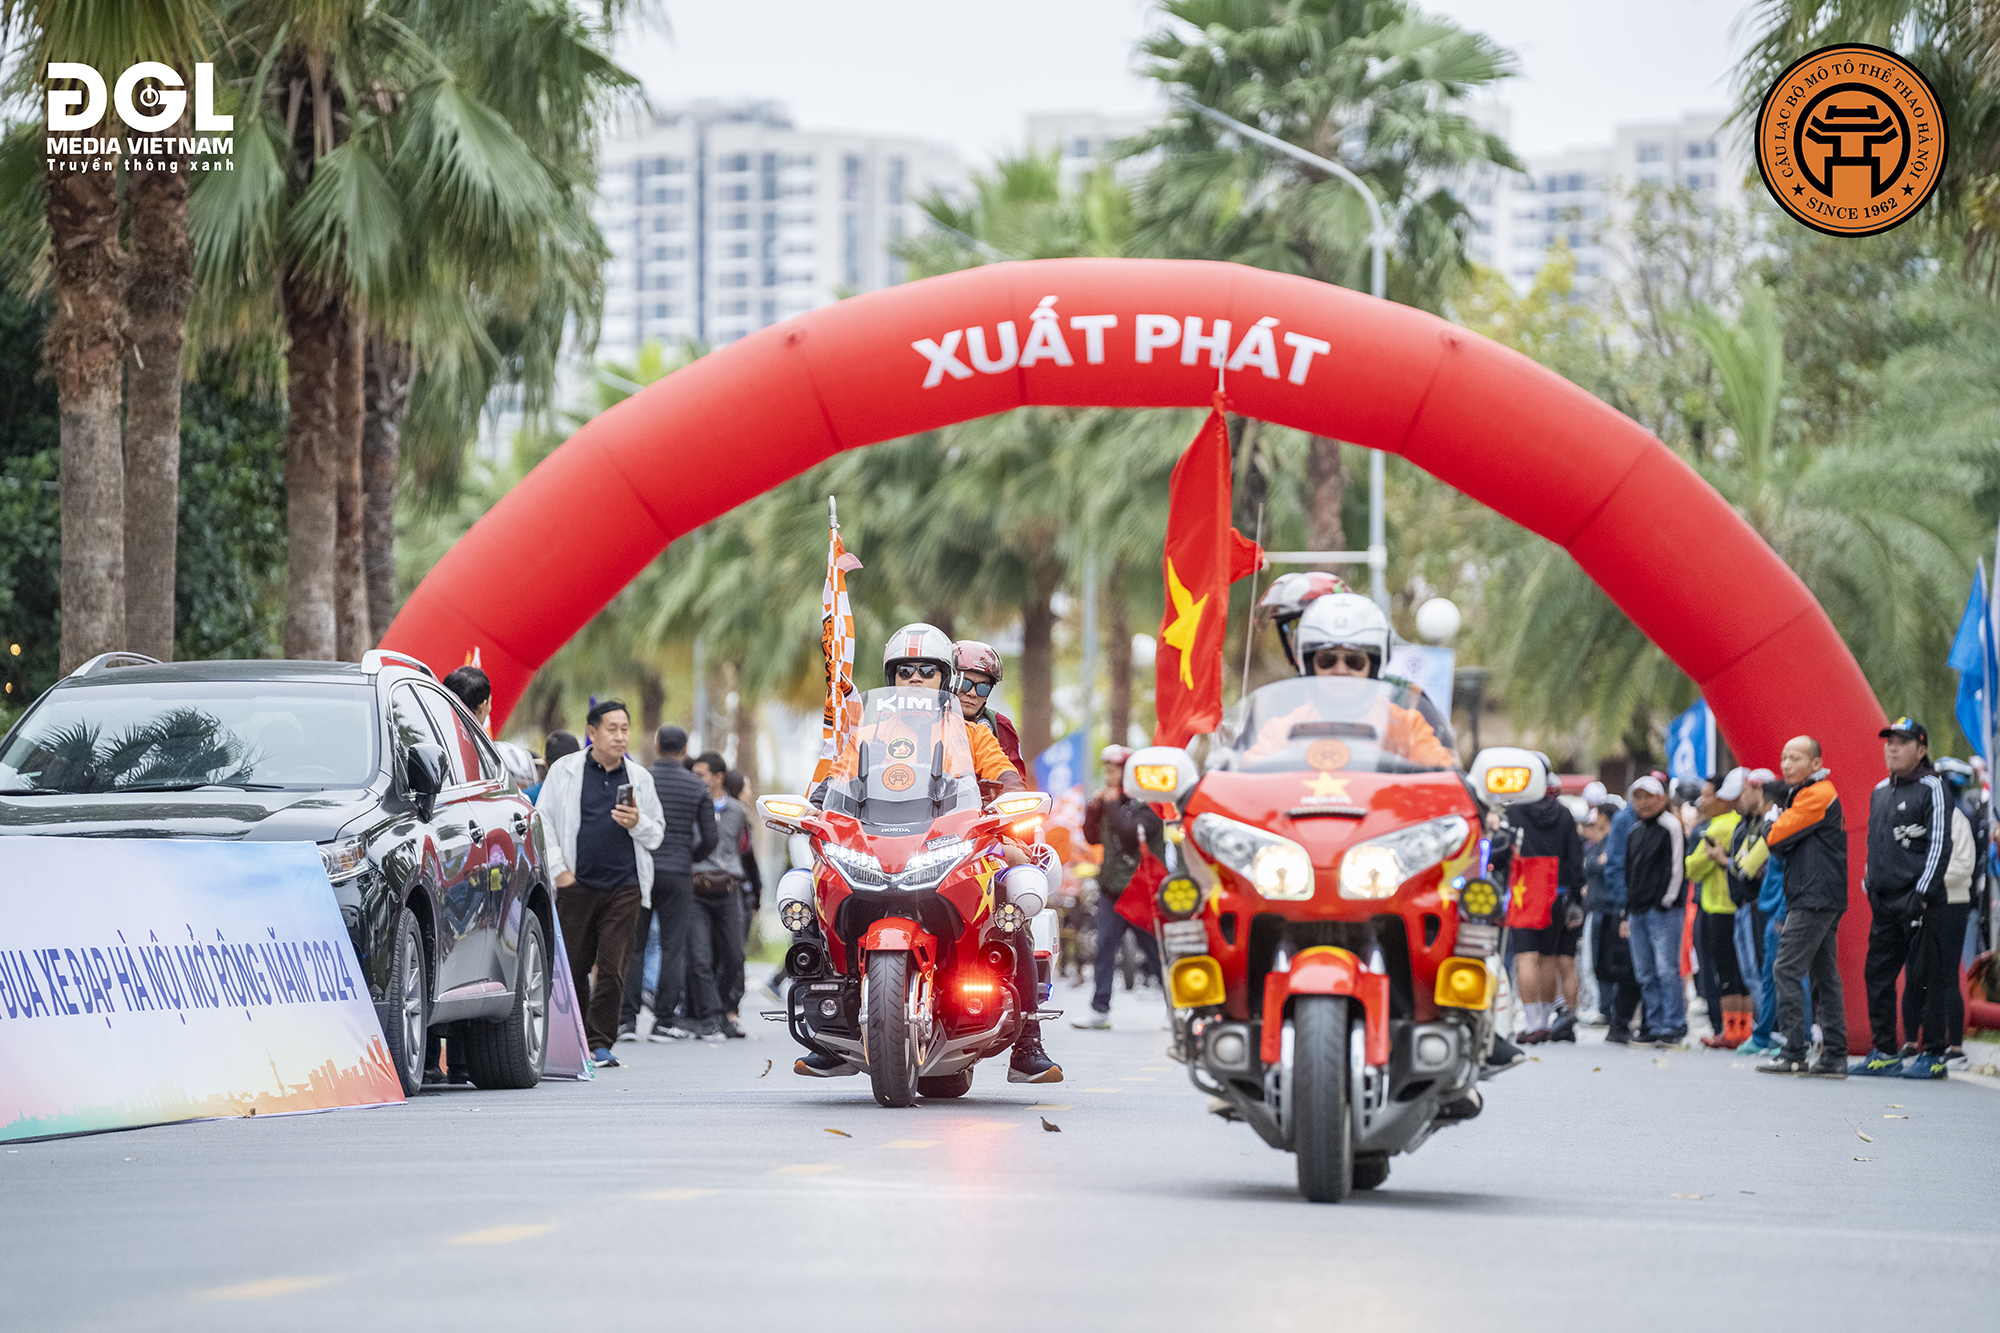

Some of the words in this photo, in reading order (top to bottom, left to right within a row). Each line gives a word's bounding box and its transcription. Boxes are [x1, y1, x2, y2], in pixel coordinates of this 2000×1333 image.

[911, 295, 1119, 389] XUẤT
[1135, 313, 1331, 386] PHÁT
[876, 693, 932, 713] KIM
[33, 948, 80, 1016] XE
[64, 947, 116, 1029] ĐẠP
[107, 929, 155, 1012] HÀ
[138, 929, 189, 1026] NỘI
[174, 923, 220, 1009] MỞ
[206, 928, 272, 1022] RỘNG
[258, 926, 316, 1005] NĂM
[302, 940, 358, 1002] 2024
